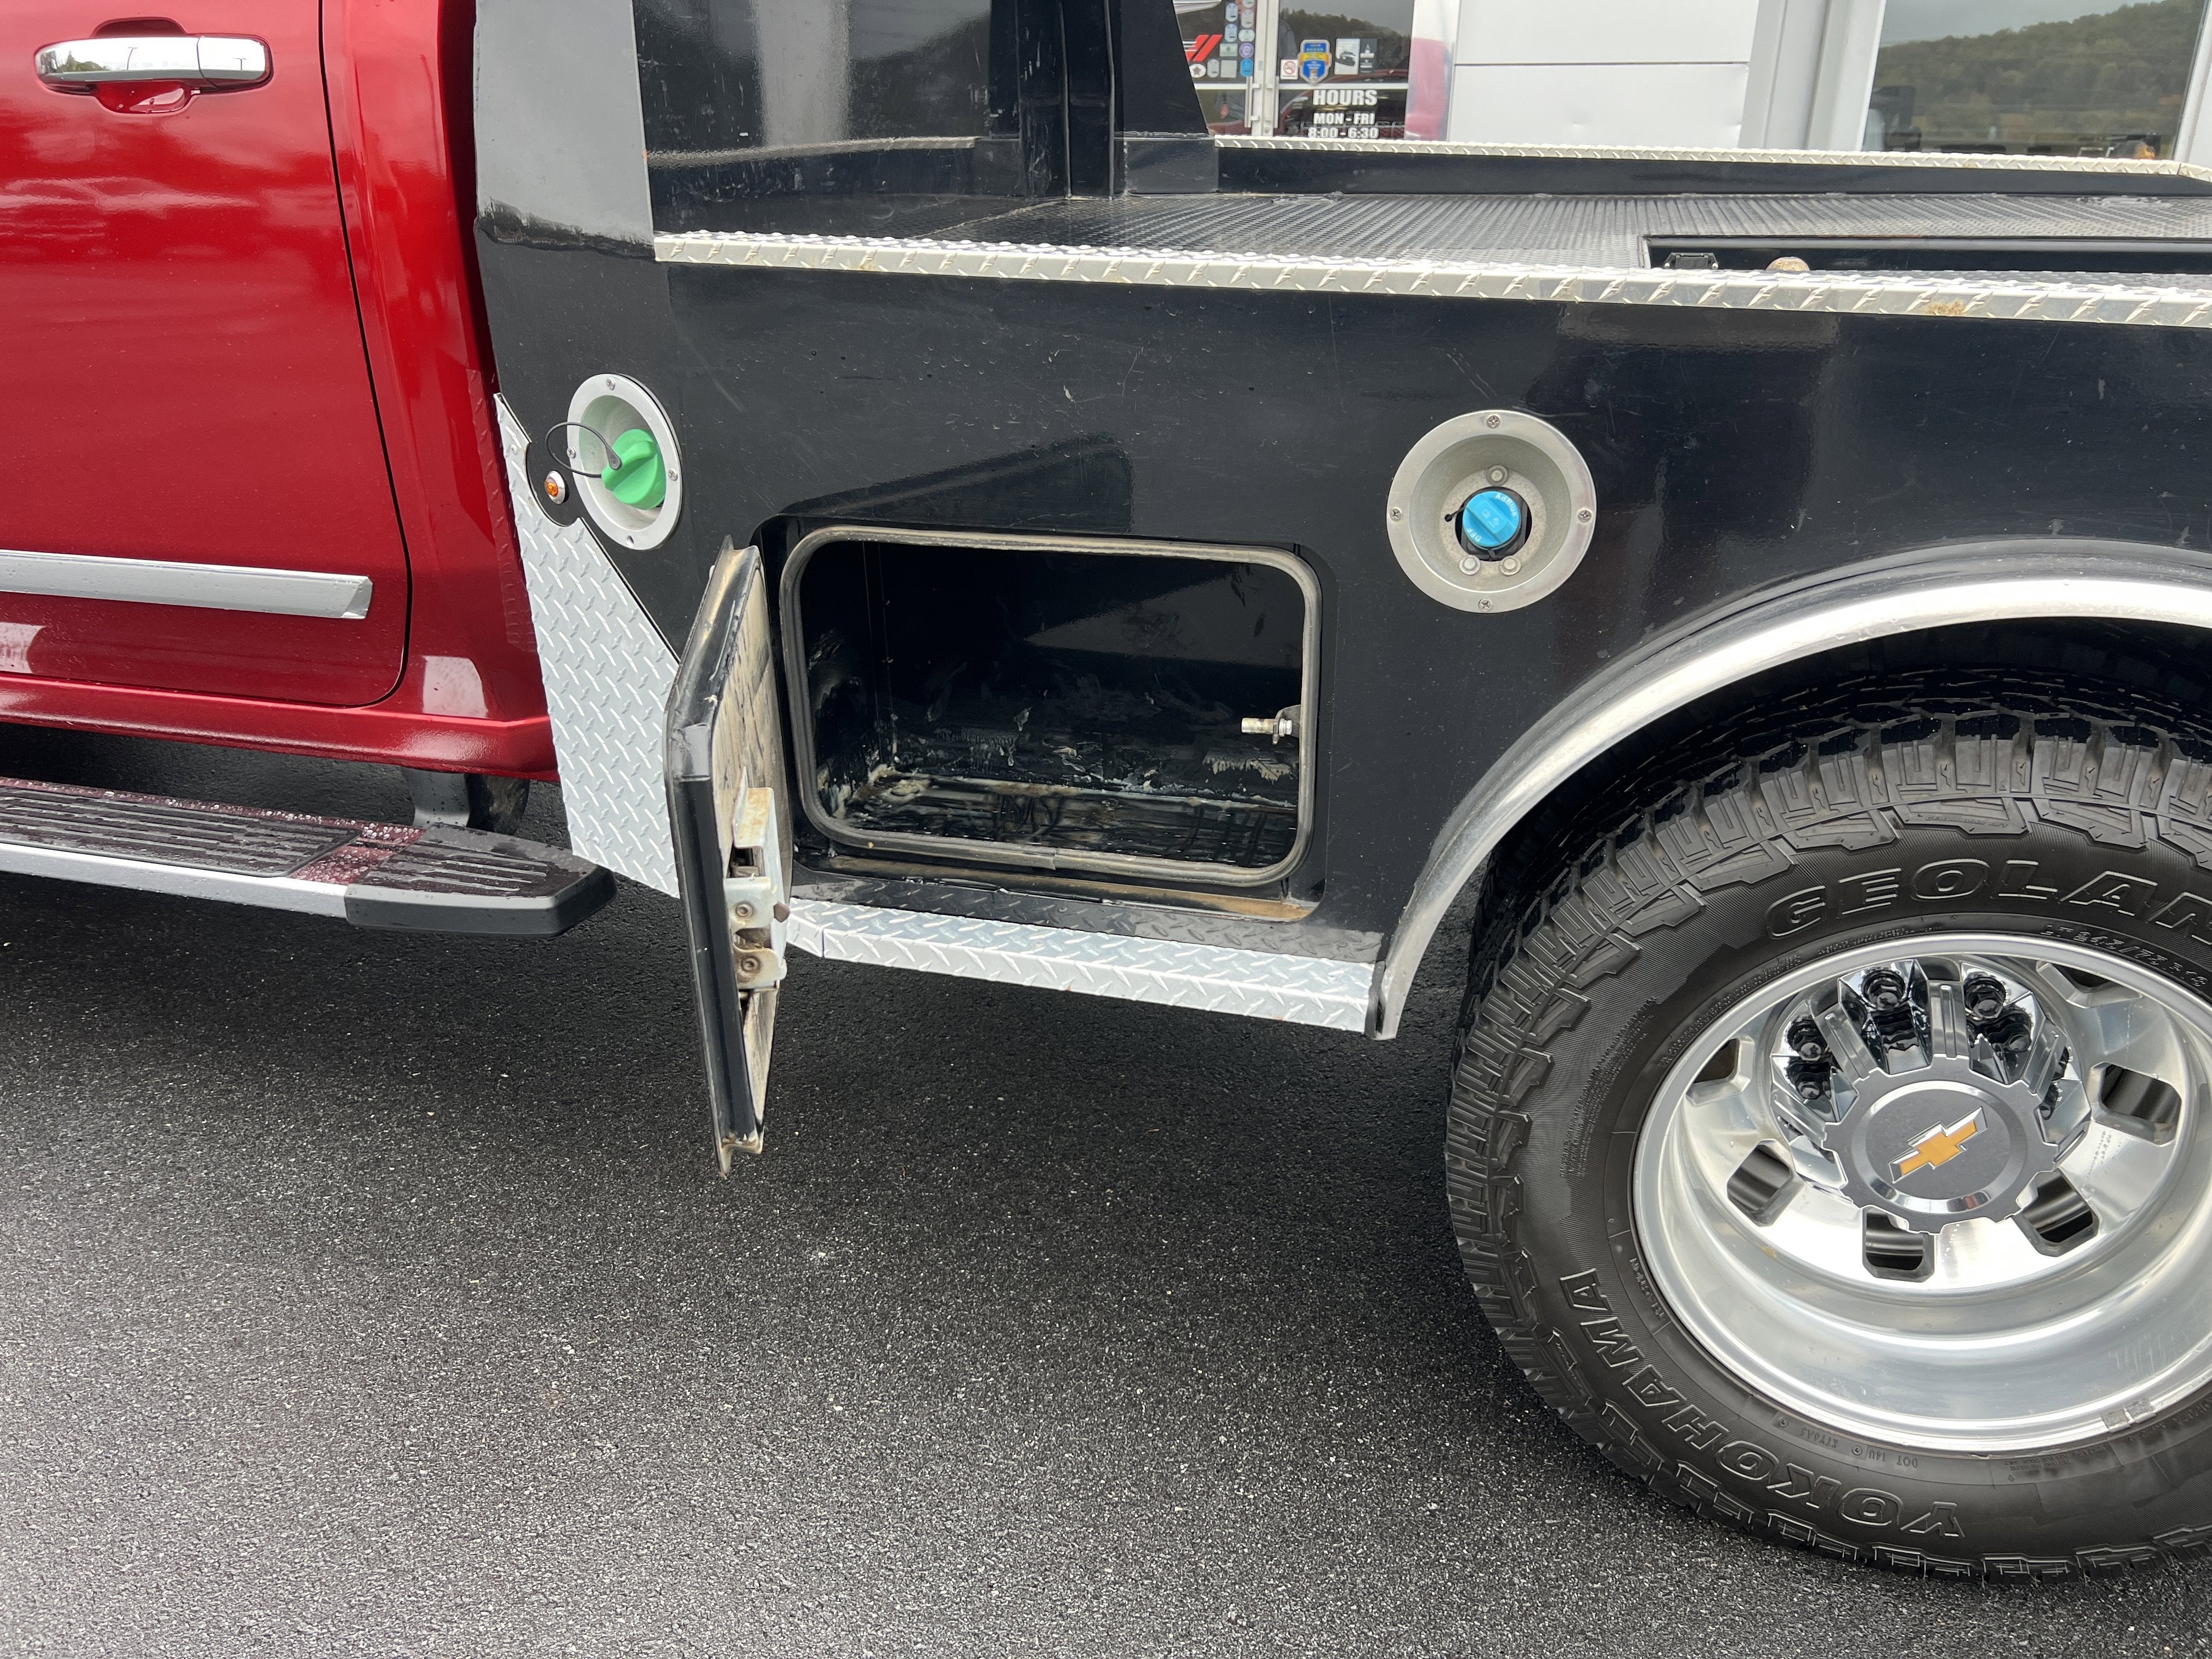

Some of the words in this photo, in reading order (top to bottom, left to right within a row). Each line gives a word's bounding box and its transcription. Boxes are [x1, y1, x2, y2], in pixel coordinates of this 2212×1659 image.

[1313, 89, 1378, 105] HOURS
[1313, 112, 1344, 125] MON
[1353, 112, 1375, 125] FRI
[1308, 127, 1339, 138] 8:00
[1348, 127, 1379, 139] 6:30
[1495, 493, 1517, 516] AdBlue
[1466, 527, 1482, 541] DEF
[1560, 1268, 1965, 1537] YOKOHAMA
[1897, 1455, 1919, 1468] DOT
